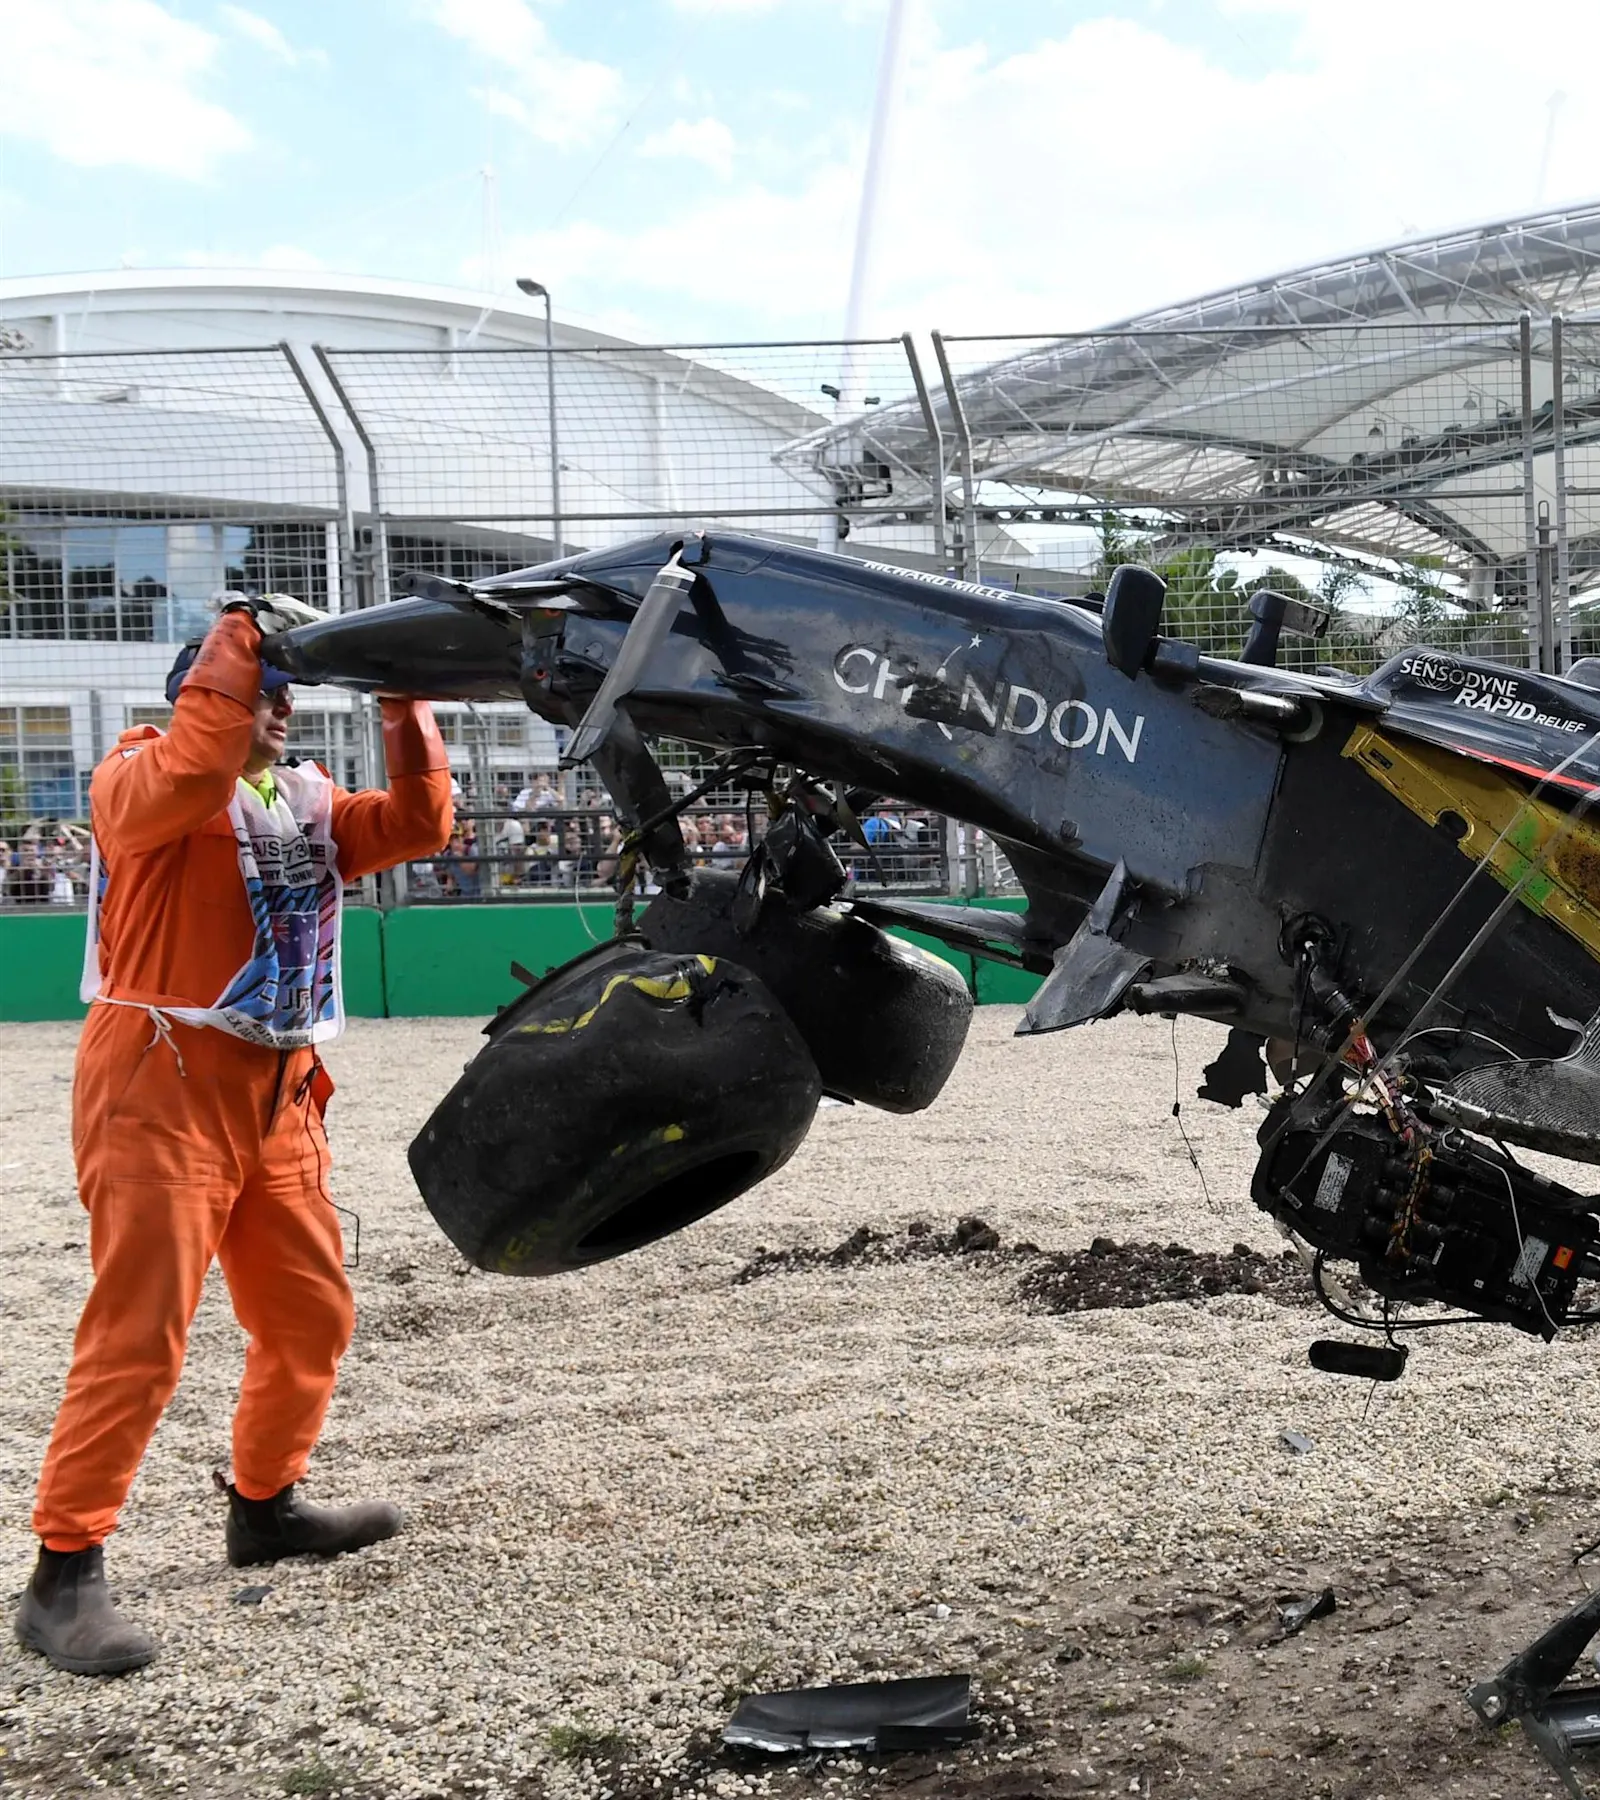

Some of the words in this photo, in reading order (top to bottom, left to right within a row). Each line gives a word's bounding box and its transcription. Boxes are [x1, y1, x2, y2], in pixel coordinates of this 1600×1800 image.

[863, 560, 947, 587] RICHARD
[951, 579, 1010, 601] MILLE
[1400, 657, 1519, 699] SENSODYNE
[833, 647, 1145, 764] CHNDON
[1453, 687, 1537, 722] RAPID
[1533, 713, 1587, 734] RELIEF
